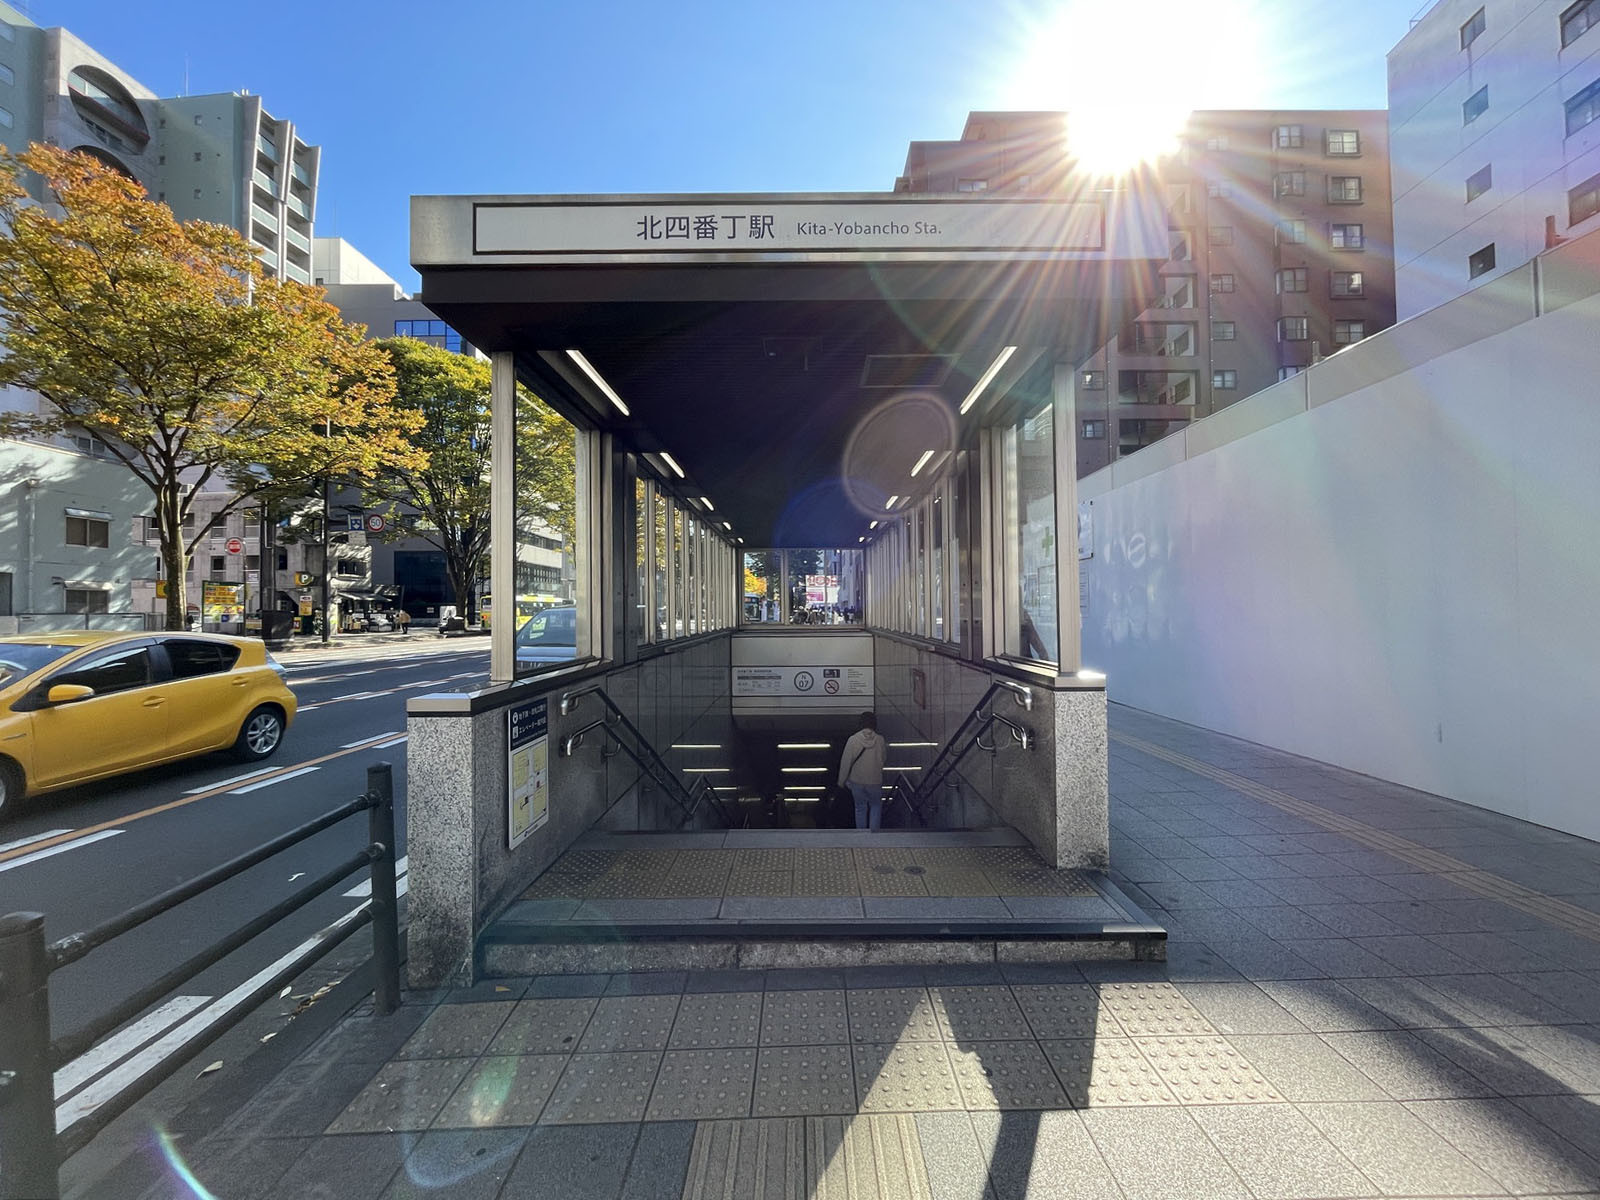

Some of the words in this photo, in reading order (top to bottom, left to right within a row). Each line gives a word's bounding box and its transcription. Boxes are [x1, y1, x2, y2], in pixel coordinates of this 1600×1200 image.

[636, 214, 775, 240] 北四番丁駅
[797, 221, 910, 235] Kita-Yobancho
[914, 221, 942, 234] Sta.
[301, 574, 309, 583] P
[799, 680, 809, 688] 07
